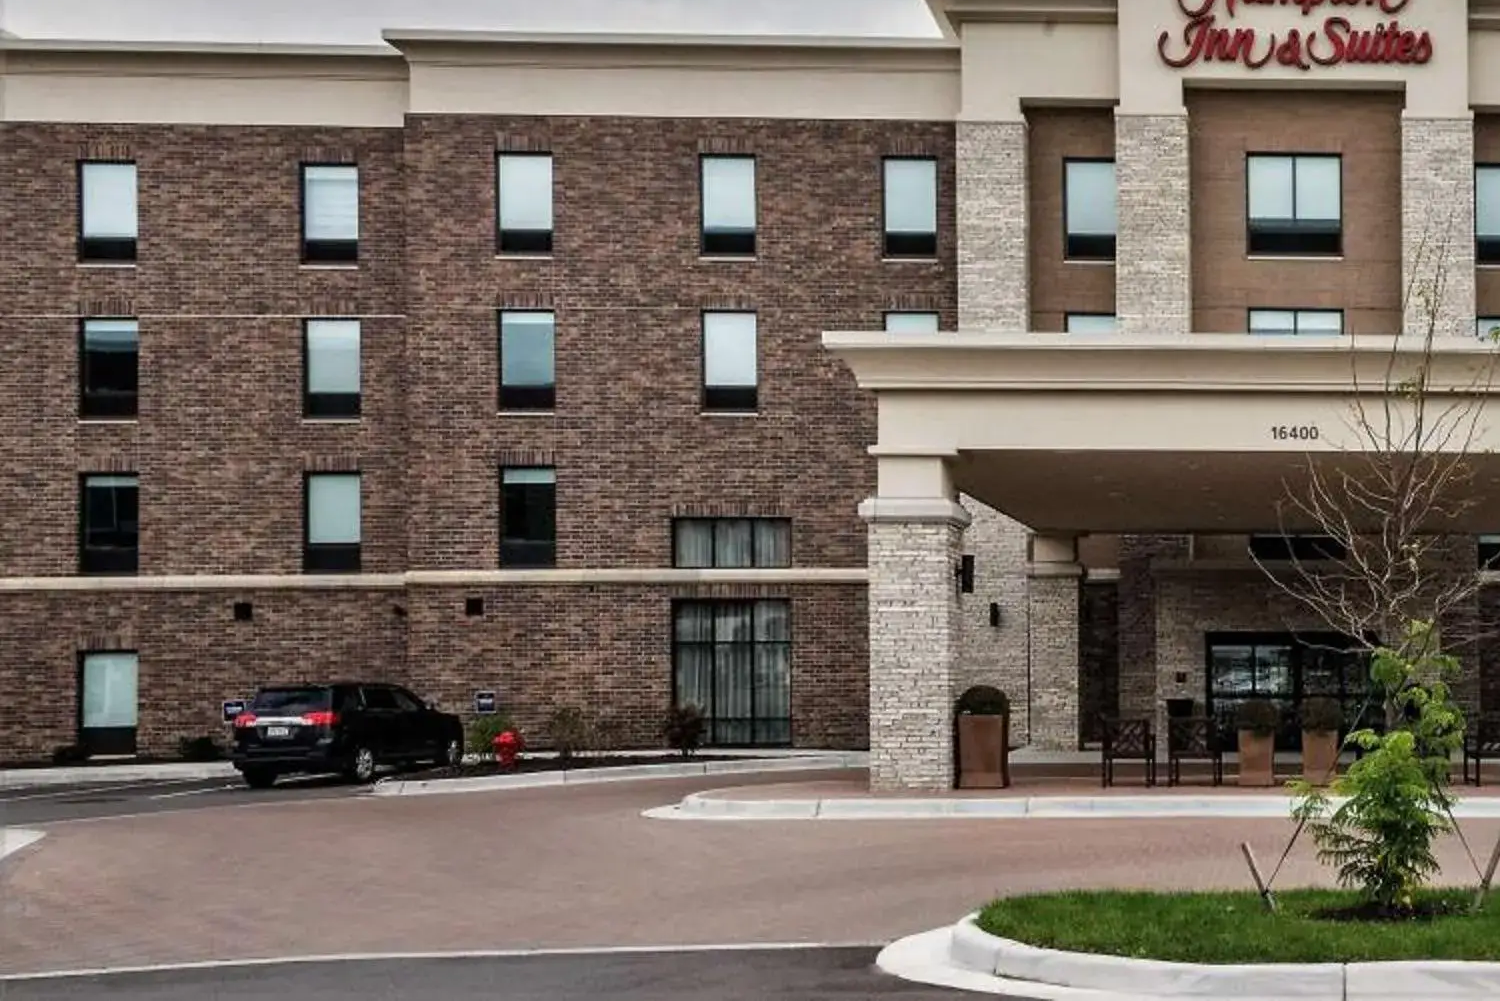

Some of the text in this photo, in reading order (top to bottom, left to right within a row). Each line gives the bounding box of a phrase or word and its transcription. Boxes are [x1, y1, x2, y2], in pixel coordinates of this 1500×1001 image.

[1158, 15, 1433, 70] Inn & Suites
[1271, 425, 1319, 440] 16400
